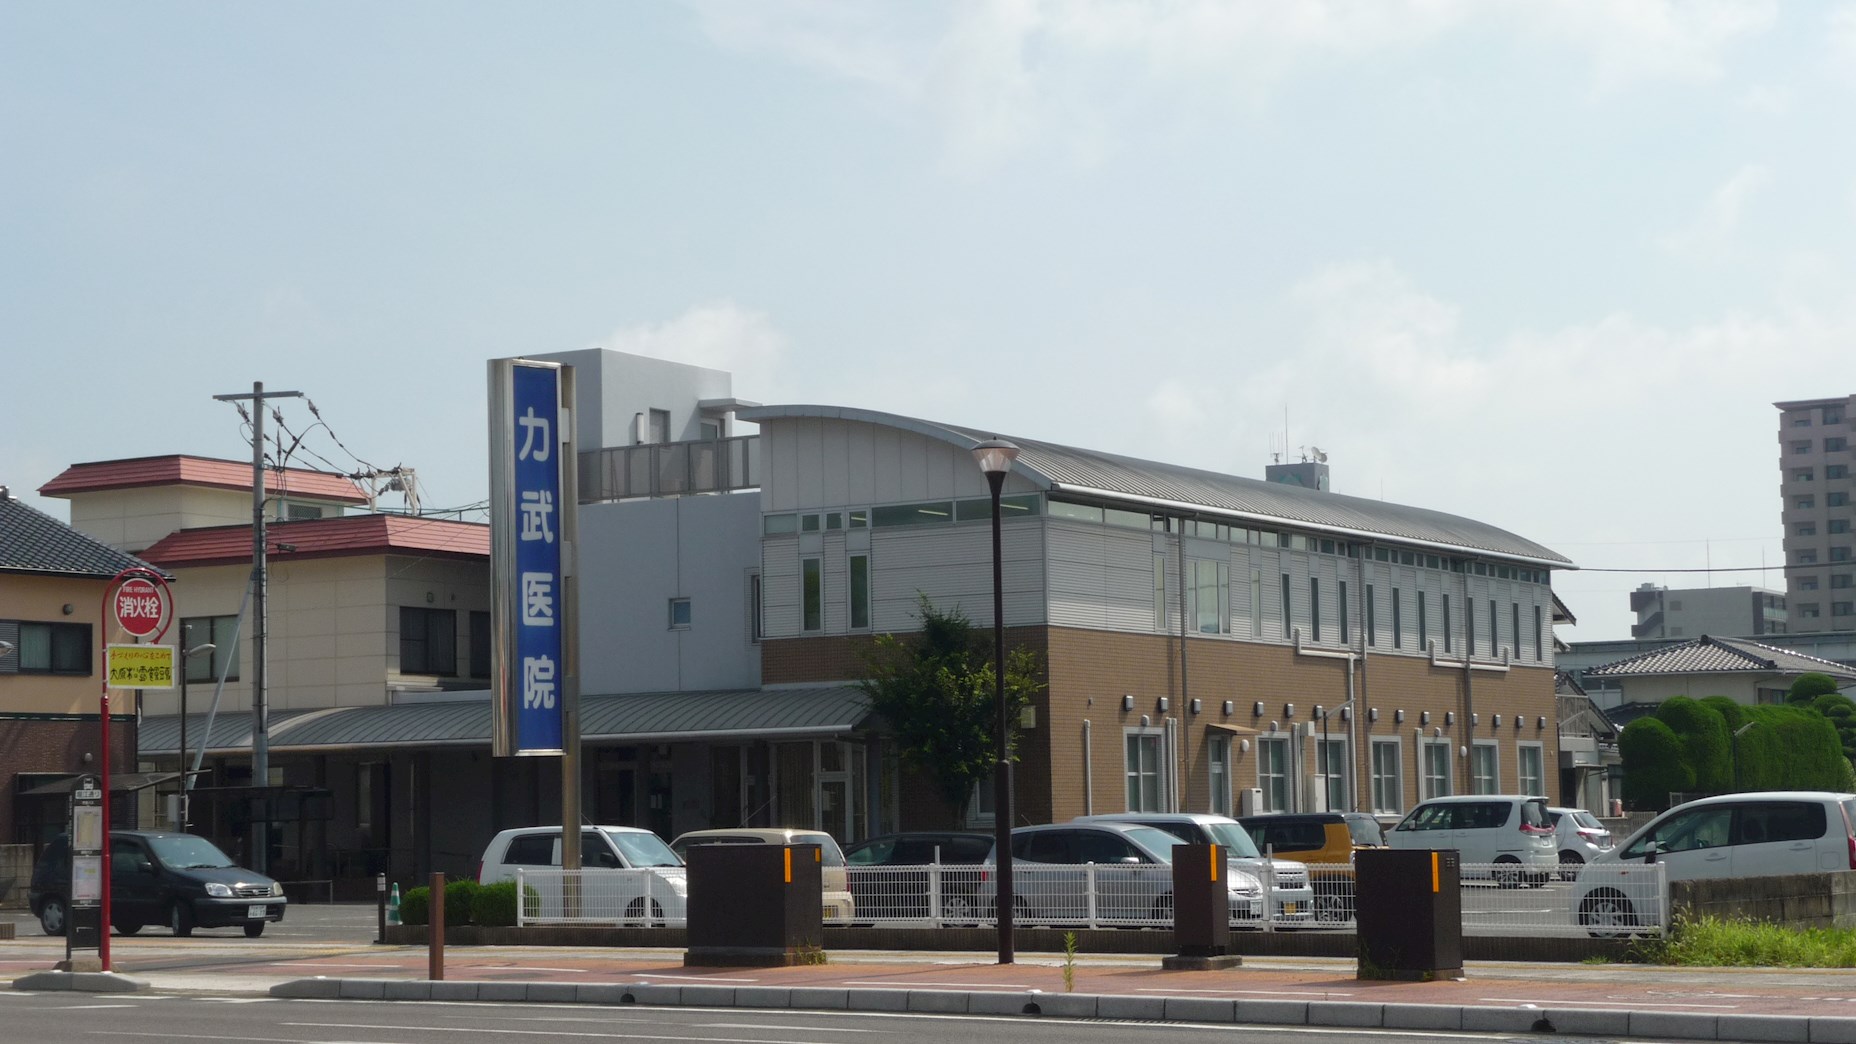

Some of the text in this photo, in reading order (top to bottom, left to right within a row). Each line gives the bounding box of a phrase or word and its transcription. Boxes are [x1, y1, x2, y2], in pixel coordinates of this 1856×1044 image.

[119, 596, 159, 618] 消火栓
[518, 407, 555, 710] 力武医院
